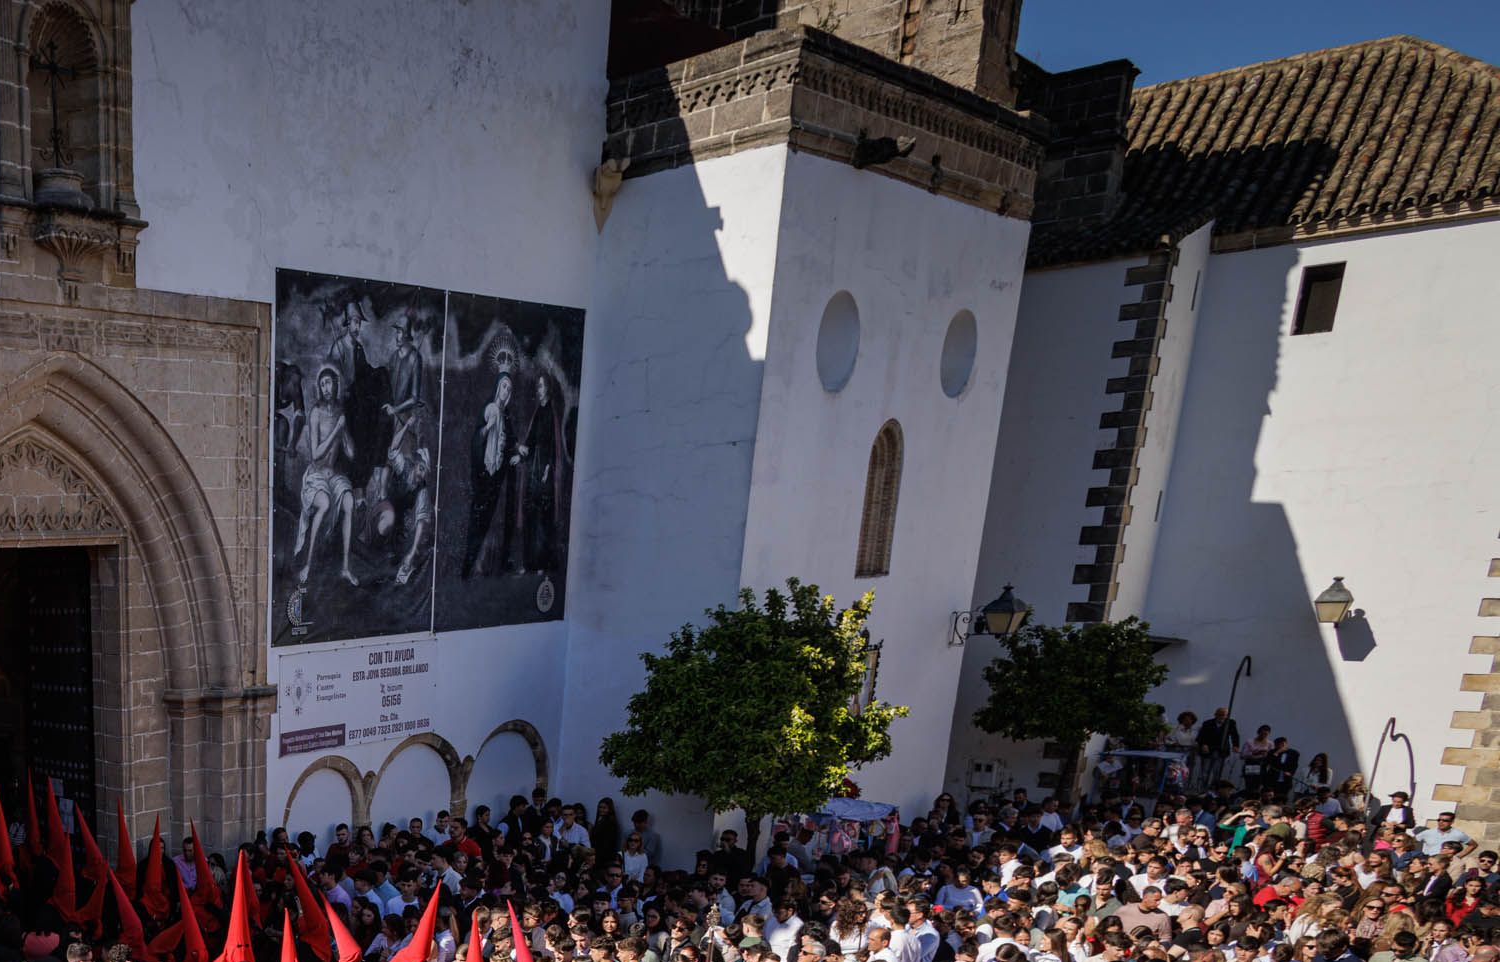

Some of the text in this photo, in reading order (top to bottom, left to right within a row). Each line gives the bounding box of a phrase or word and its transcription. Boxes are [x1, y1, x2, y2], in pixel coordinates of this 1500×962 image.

[368, 648, 415, 665] CON TU AYUDA
[352, 670, 366, 682] ESTA
[366, 669, 380, 680] JOYA
